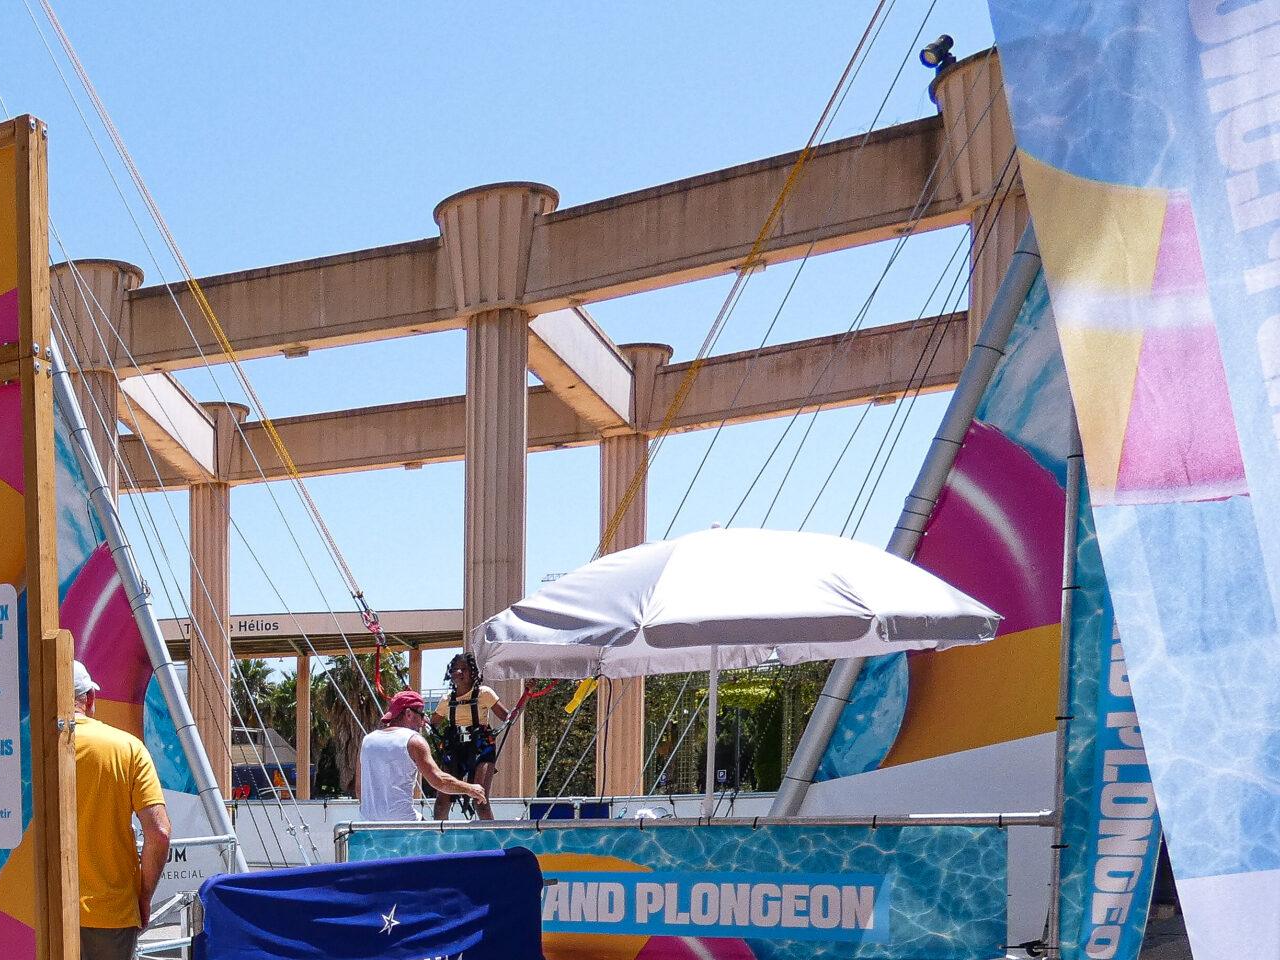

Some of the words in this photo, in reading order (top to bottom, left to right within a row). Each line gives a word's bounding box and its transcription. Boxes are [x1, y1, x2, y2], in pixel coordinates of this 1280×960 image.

[0, 623, 4, 640] !
[238, 619, 279, 632] Hélios
[635, 881, 875, 930] PLONGEON
